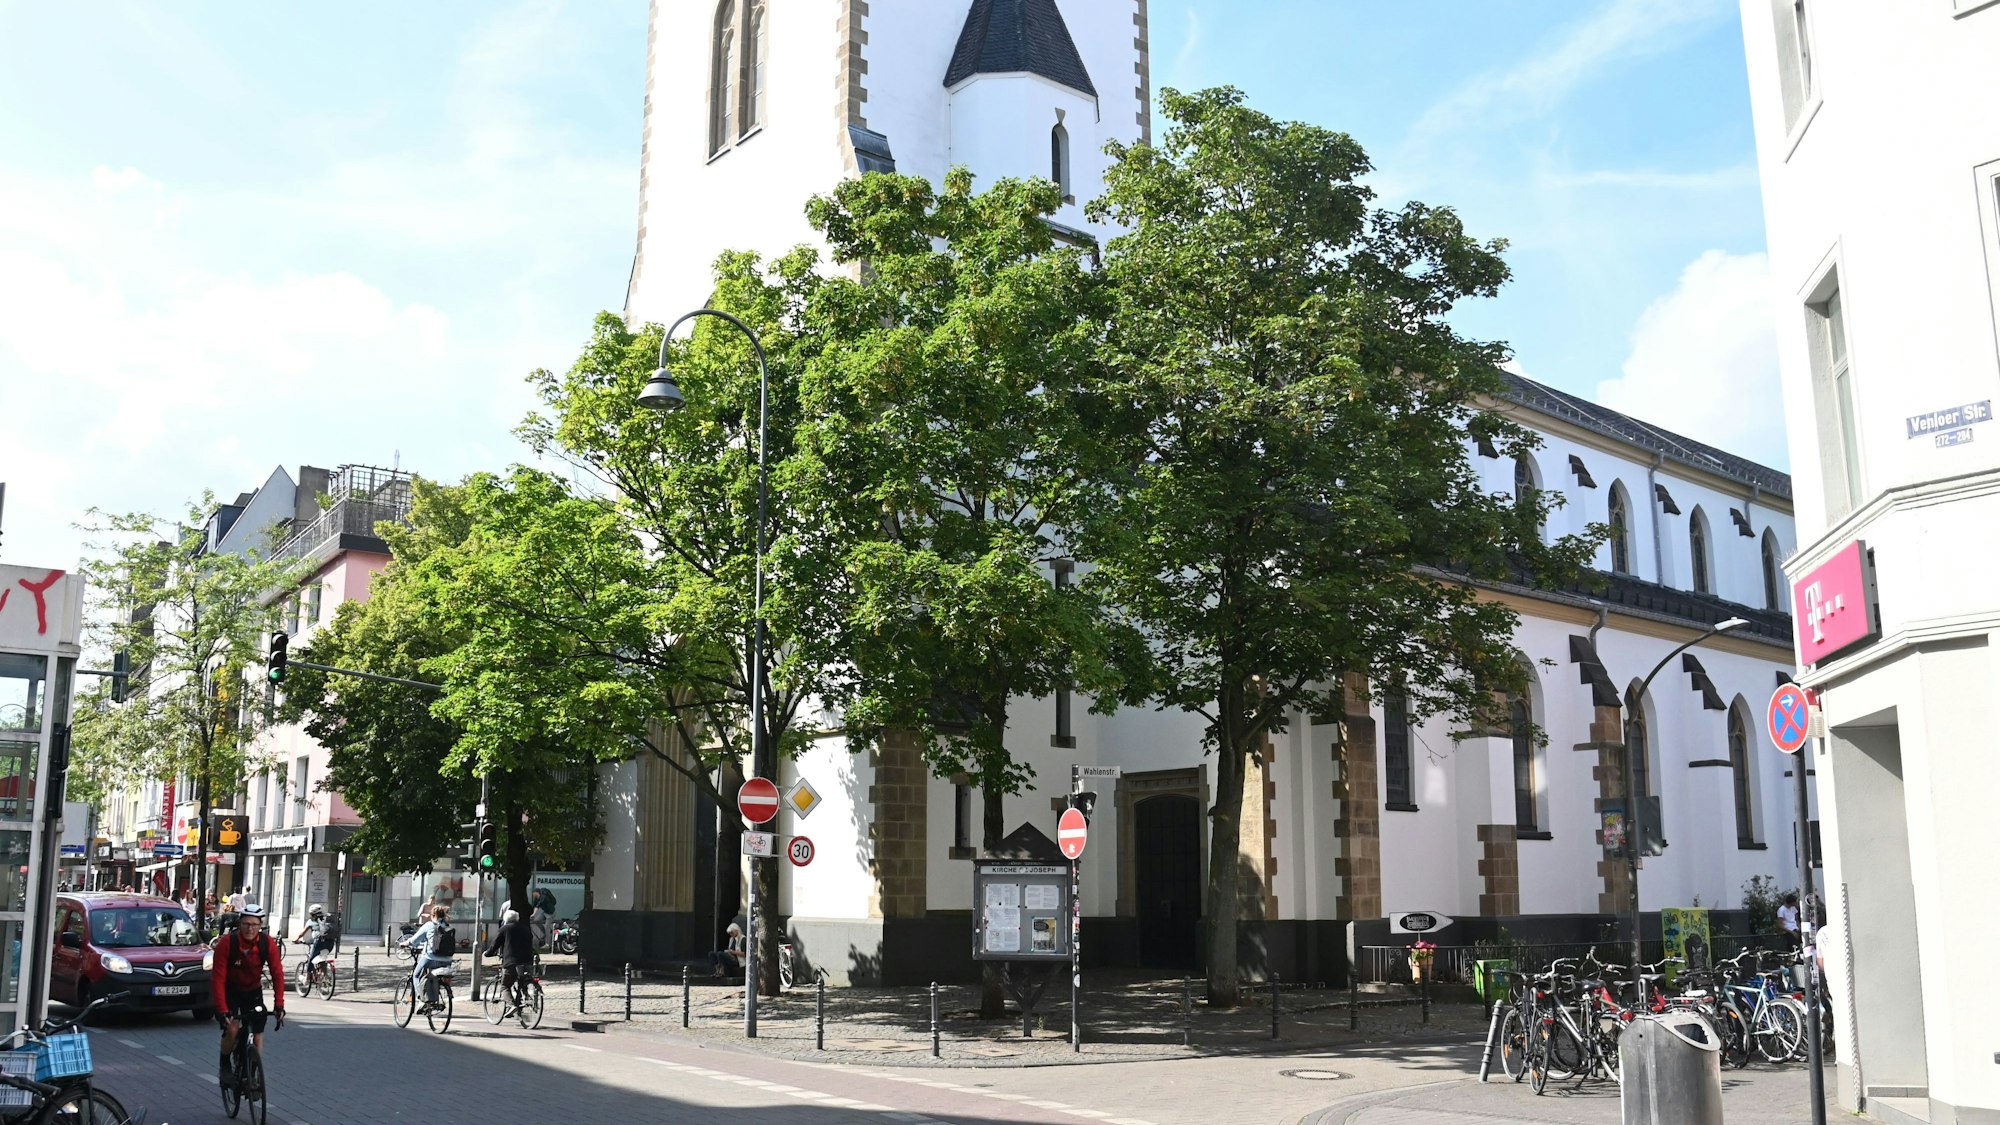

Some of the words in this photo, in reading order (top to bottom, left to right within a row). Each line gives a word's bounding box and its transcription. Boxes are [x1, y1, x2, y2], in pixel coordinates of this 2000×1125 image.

[1911, 411, 1960, 432] Venloer
[1963, 404, 1987, 420] Str.
[1083, 767, 1117, 776] Wahlenstr.
[793, 844, 809, 859] 30
